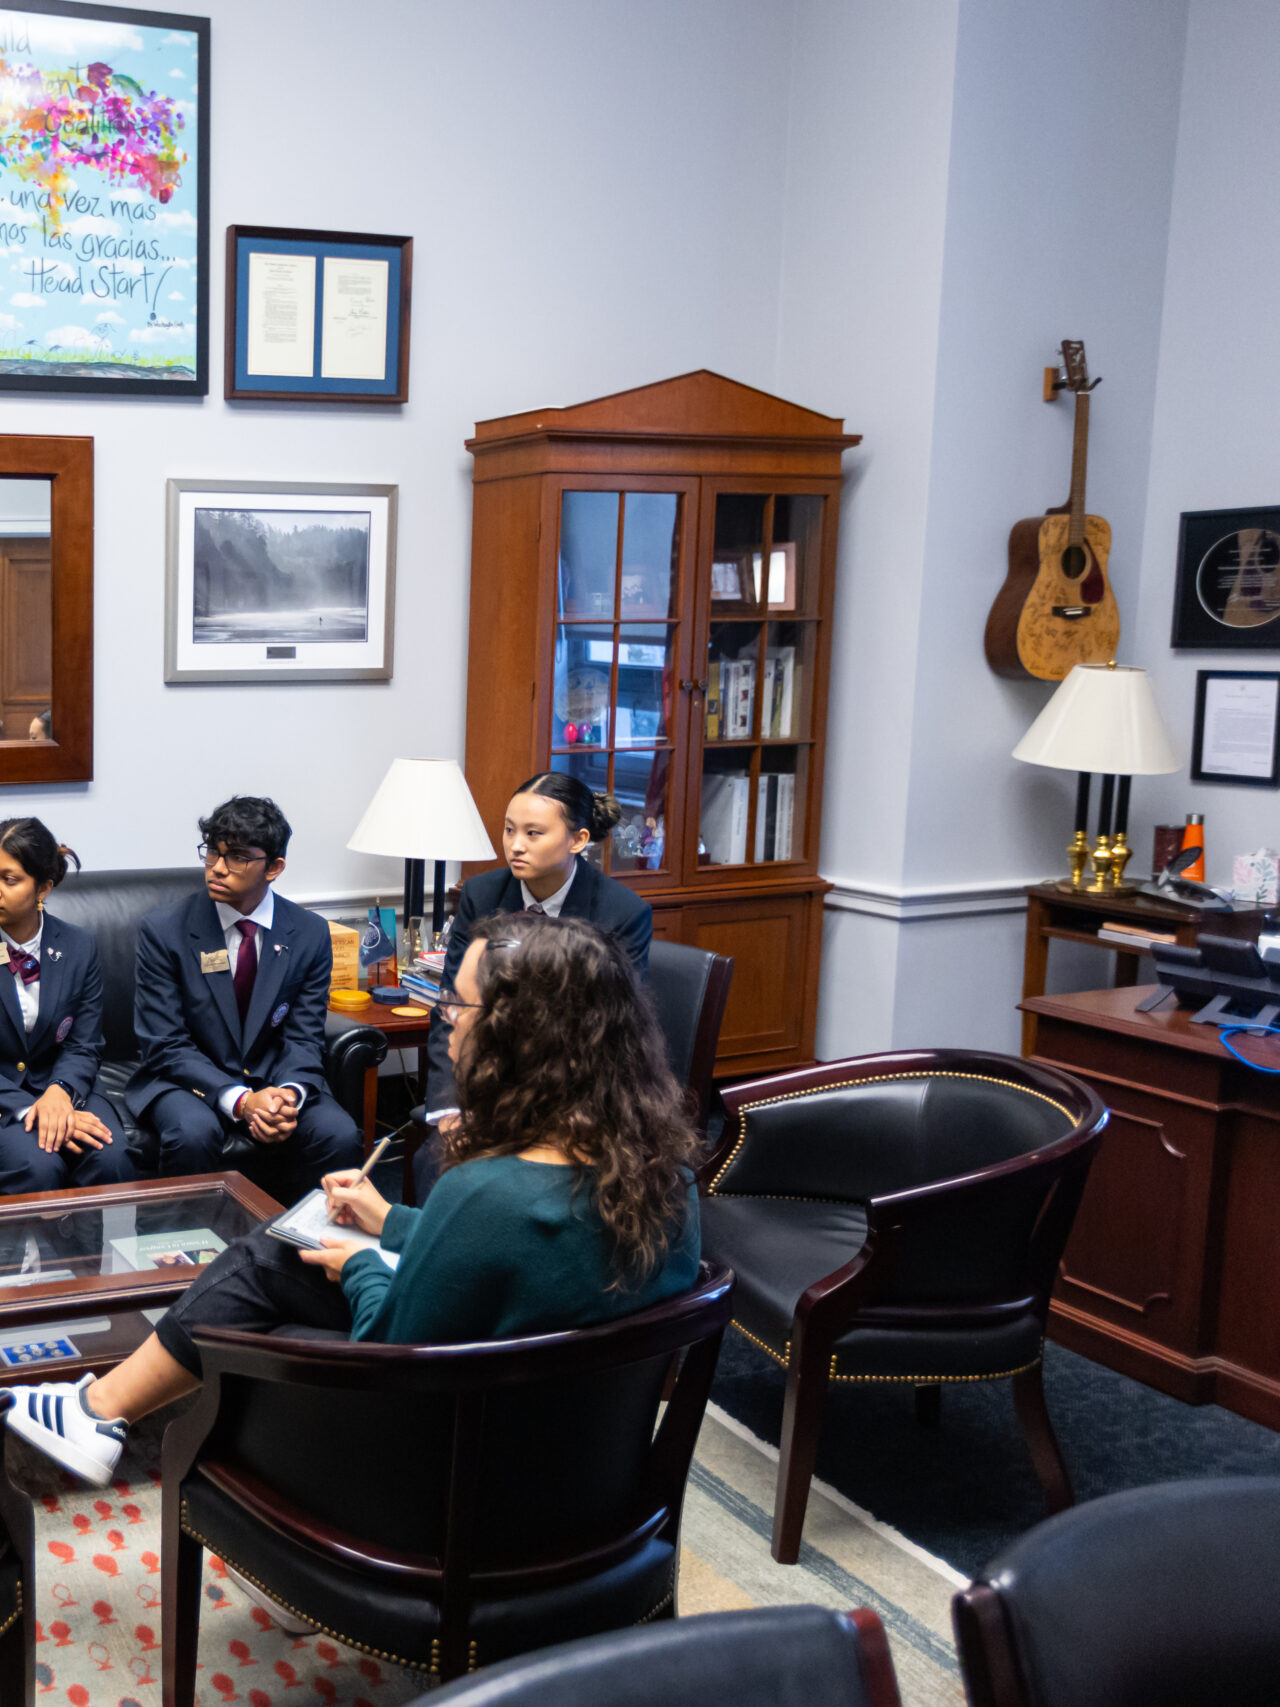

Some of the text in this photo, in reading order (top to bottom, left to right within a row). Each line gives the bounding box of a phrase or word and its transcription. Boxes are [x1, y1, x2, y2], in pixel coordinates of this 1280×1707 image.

[63, 189, 104, 218] vez
[110, 199, 157, 224] mas
[41, 214, 73, 251] las
[23, 256, 85, 294] Head
